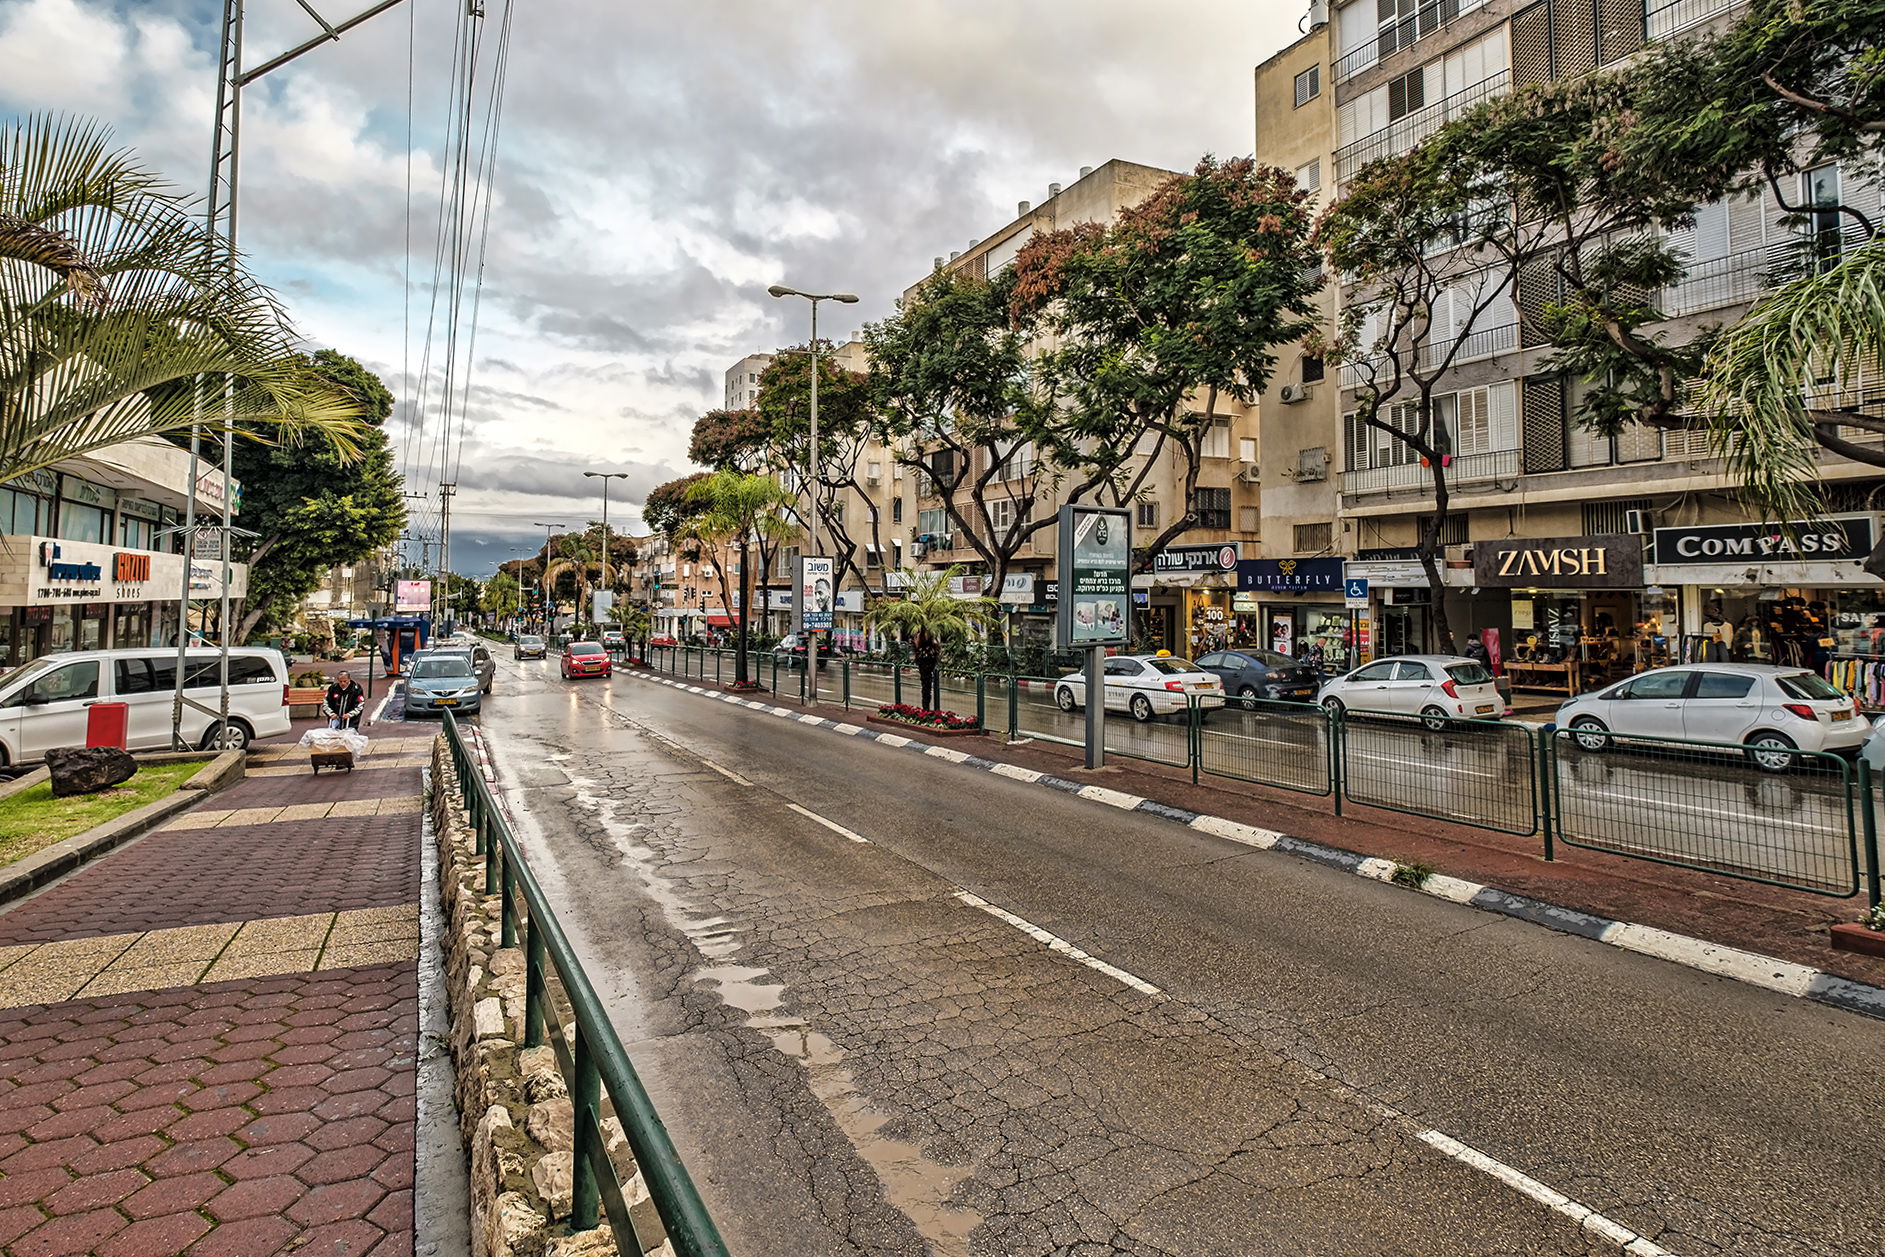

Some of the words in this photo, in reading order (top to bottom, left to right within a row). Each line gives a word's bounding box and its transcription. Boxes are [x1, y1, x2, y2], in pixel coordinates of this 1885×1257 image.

[1676, 532, 1842, 557] COMPASS
[1157, 549, 1184, 566] שולה
[1185, 550, 1218, 570] ארנקי
[1498, 547, 1608, 577] ZAMSH
[807, 562, 829, 572] משוב
[1247, 575, 1331, 585] BUTTERFLY
[116, 584, 140, 599] shoes
[1206, 610, 1224, 621] 100
[1840, 612, 1880, 624] SALE
[1548, 607, 1560, 649] ZAMSH
